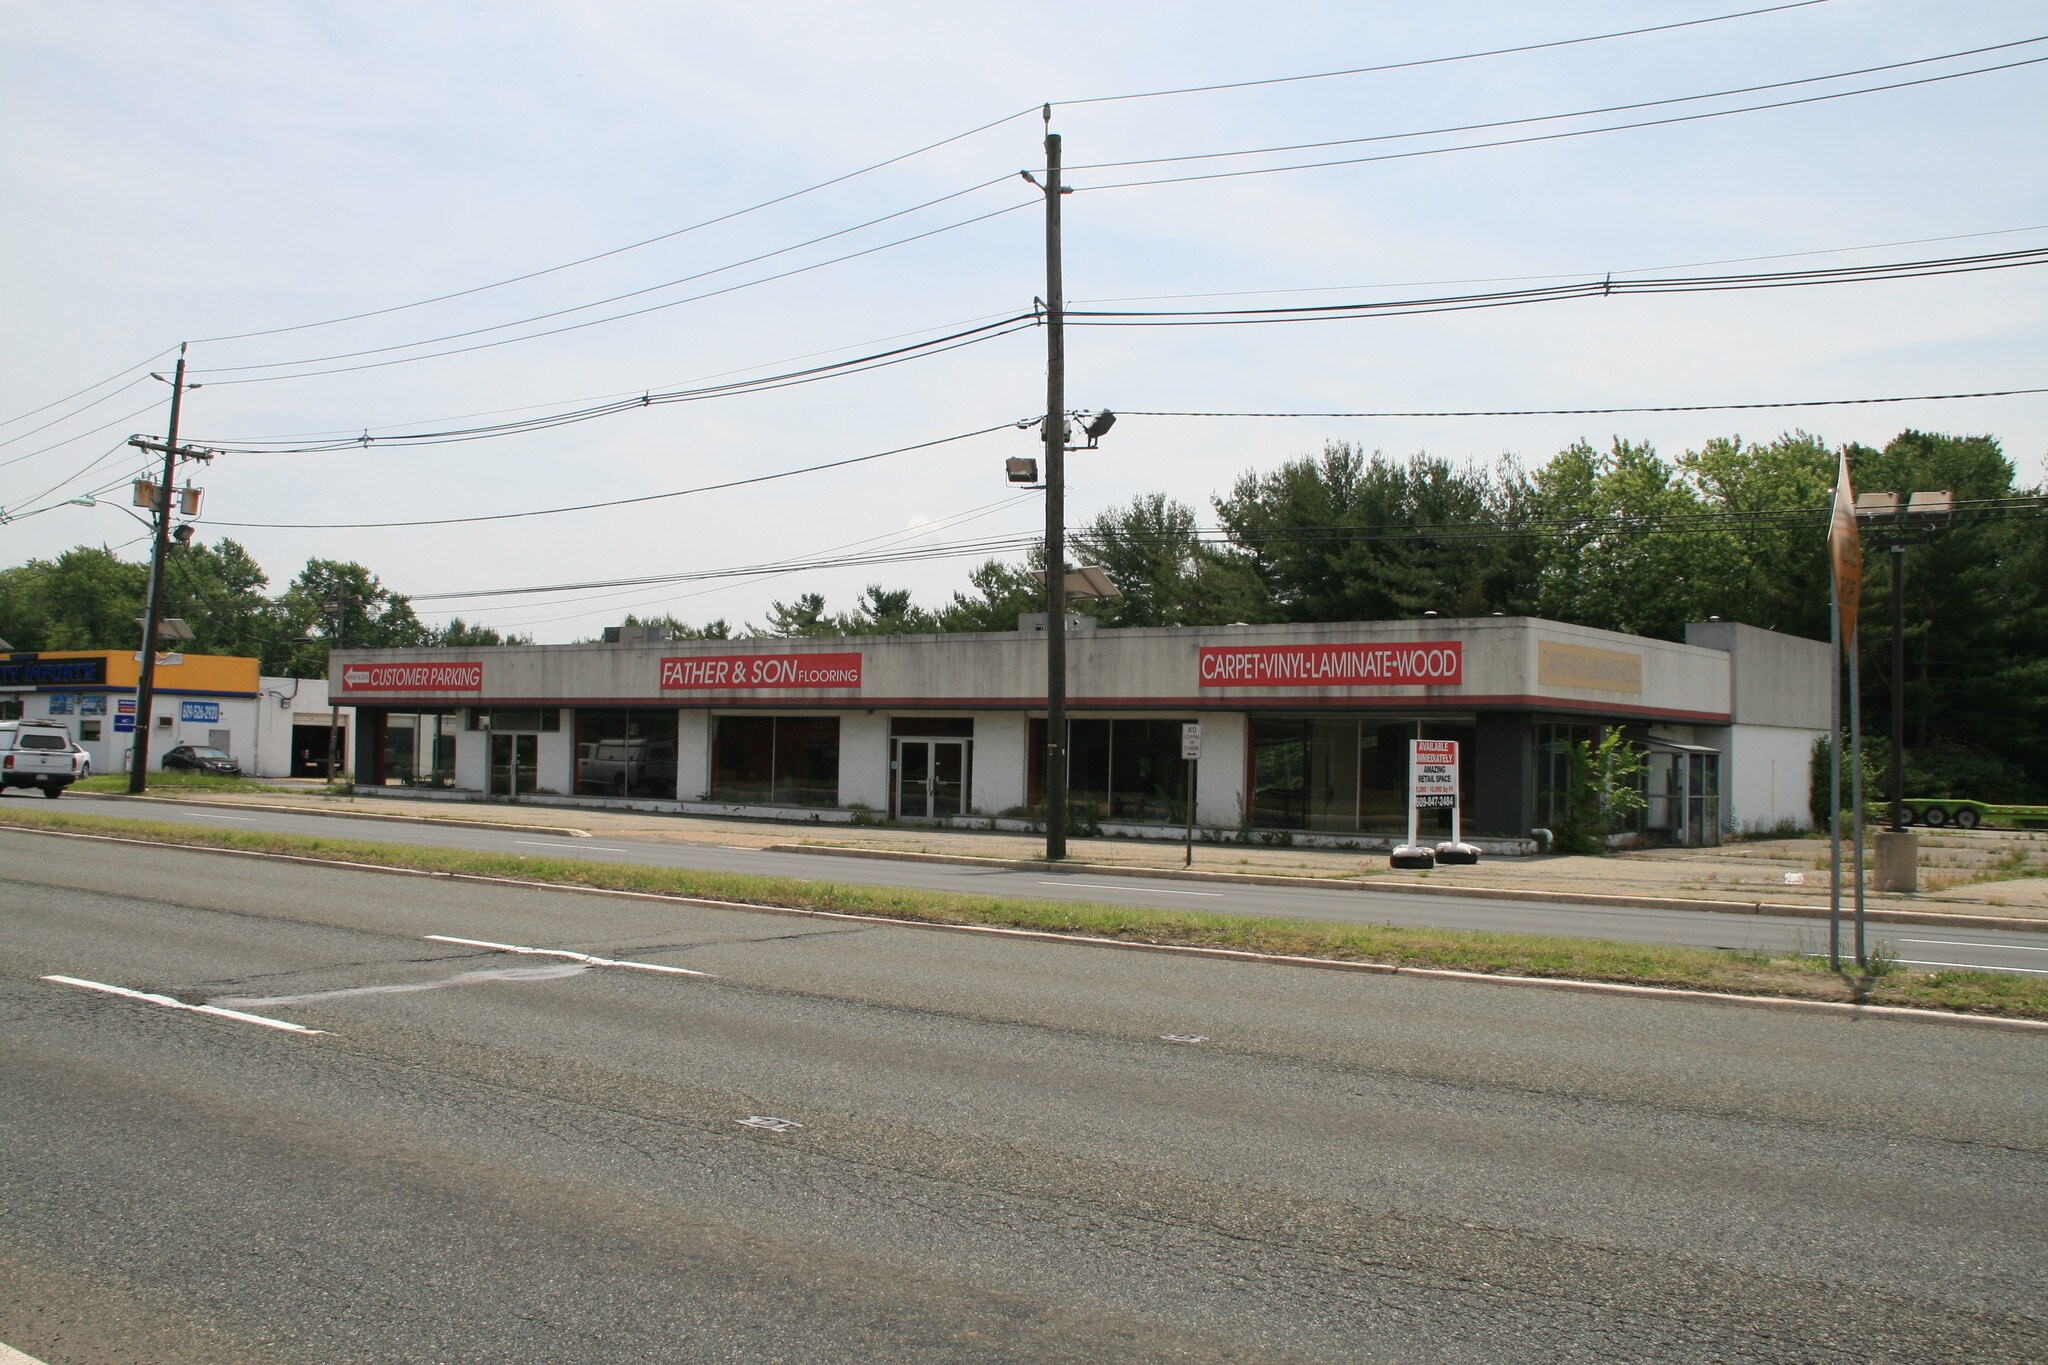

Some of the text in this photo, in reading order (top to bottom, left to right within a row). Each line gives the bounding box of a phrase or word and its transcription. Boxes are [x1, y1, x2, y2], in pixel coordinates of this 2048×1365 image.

[25, 662, 96, 681] IMPORTS
[662, 660, 858, 684] FATHER & SON FLOORING
[1202, 650, 1457, 679] CARPET VINYL LAMINATE WOOD
[371, 667, 480, 686] CUSTOMER PARKING
[183, 704, 218, 720] 609-526-2920
[1419, 742, 1448, 751] AVAILABLE
